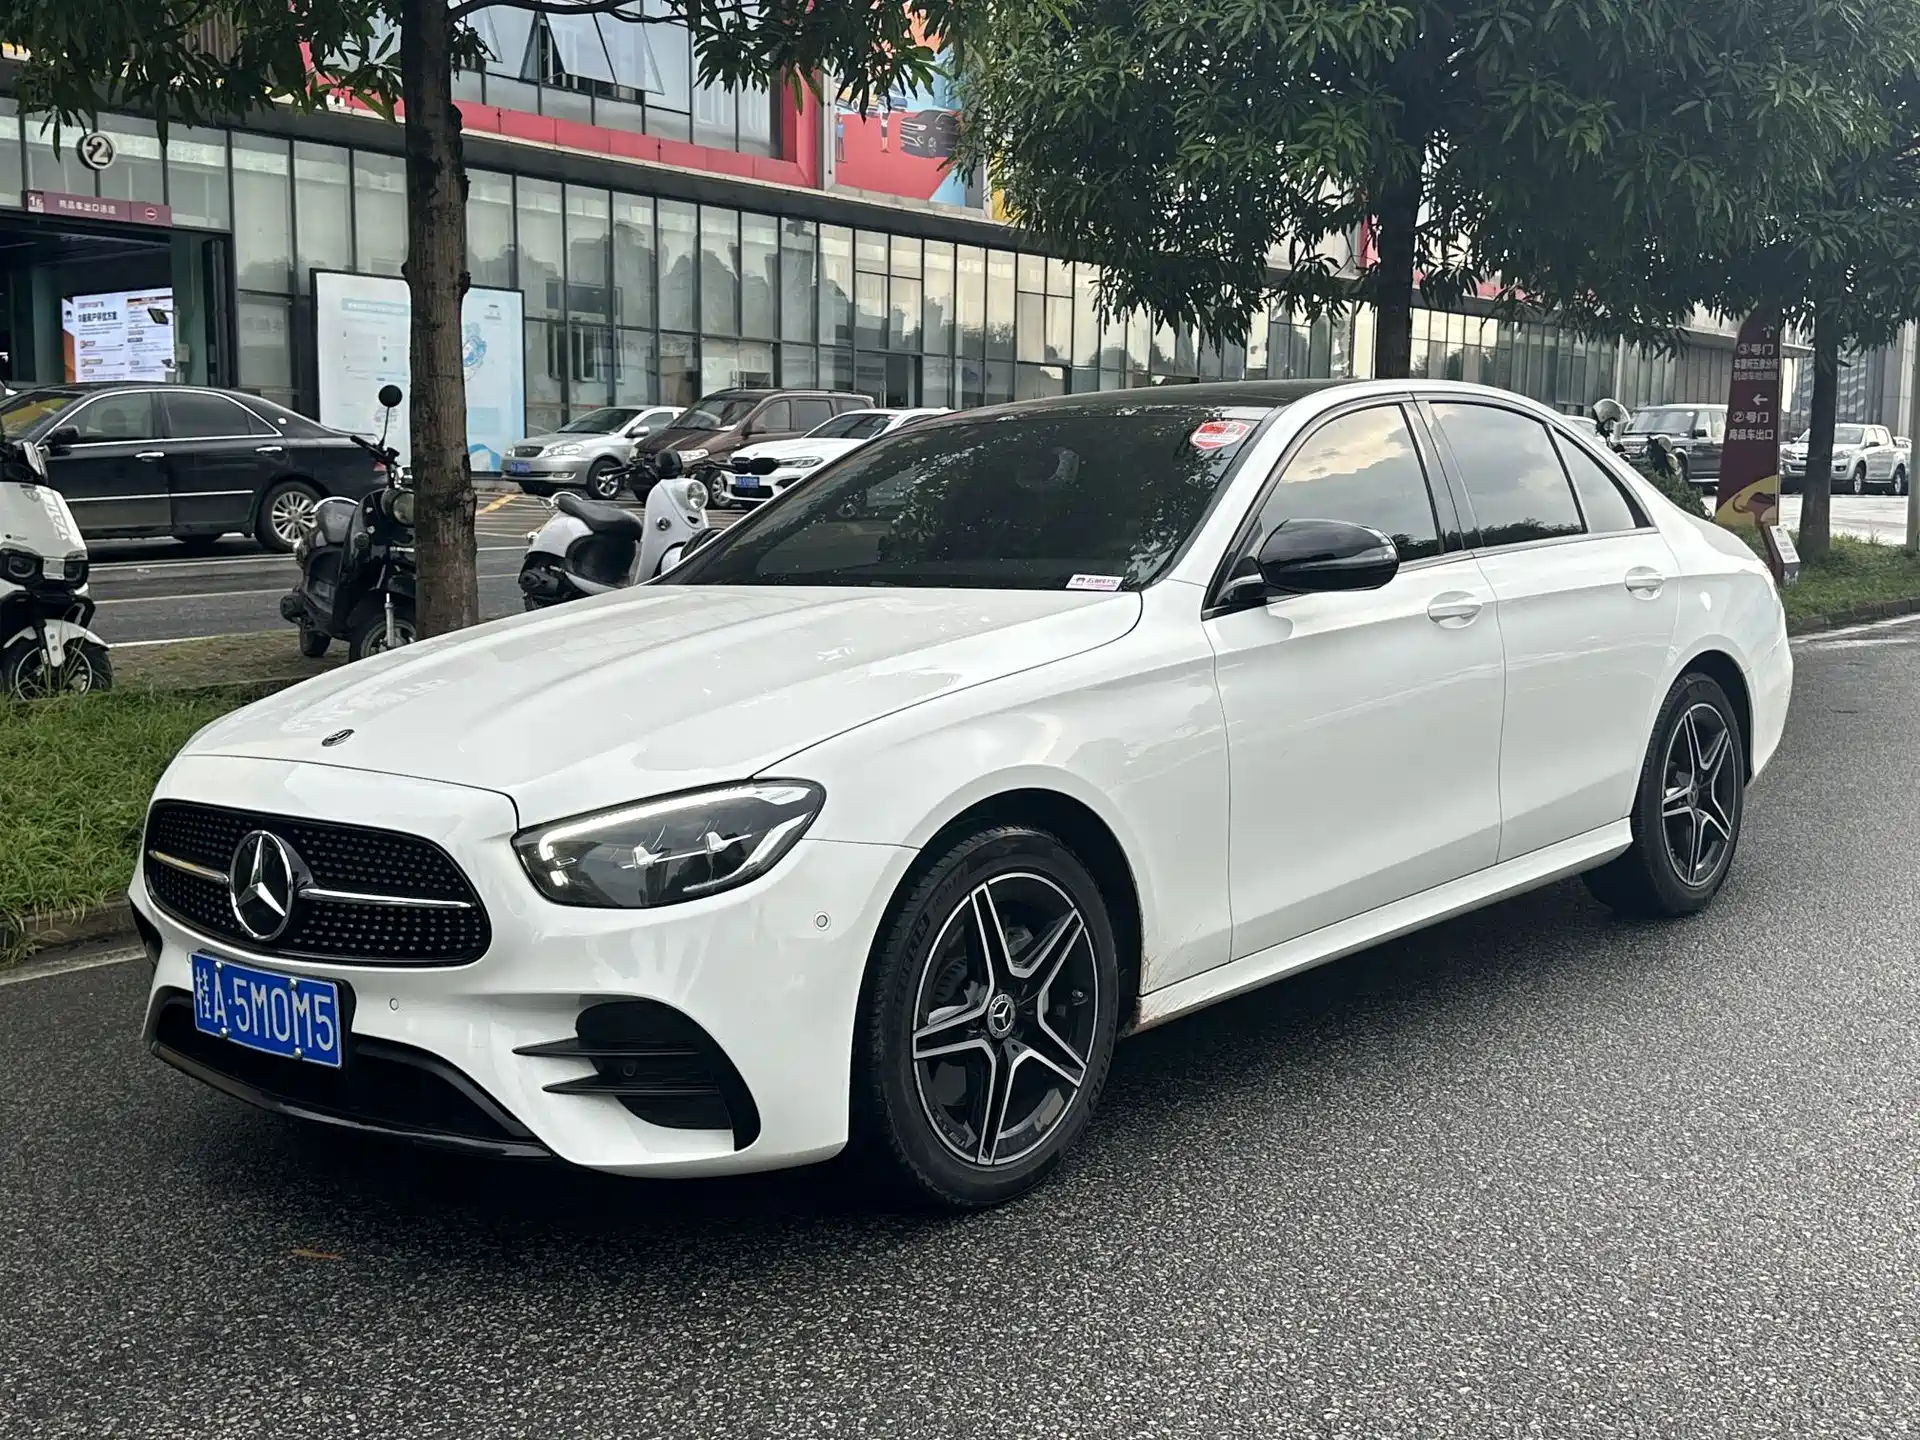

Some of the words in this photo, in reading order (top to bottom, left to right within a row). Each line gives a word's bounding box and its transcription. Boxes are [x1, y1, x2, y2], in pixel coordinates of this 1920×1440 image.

[1729, 428, 1774, 440] 商品车出口
